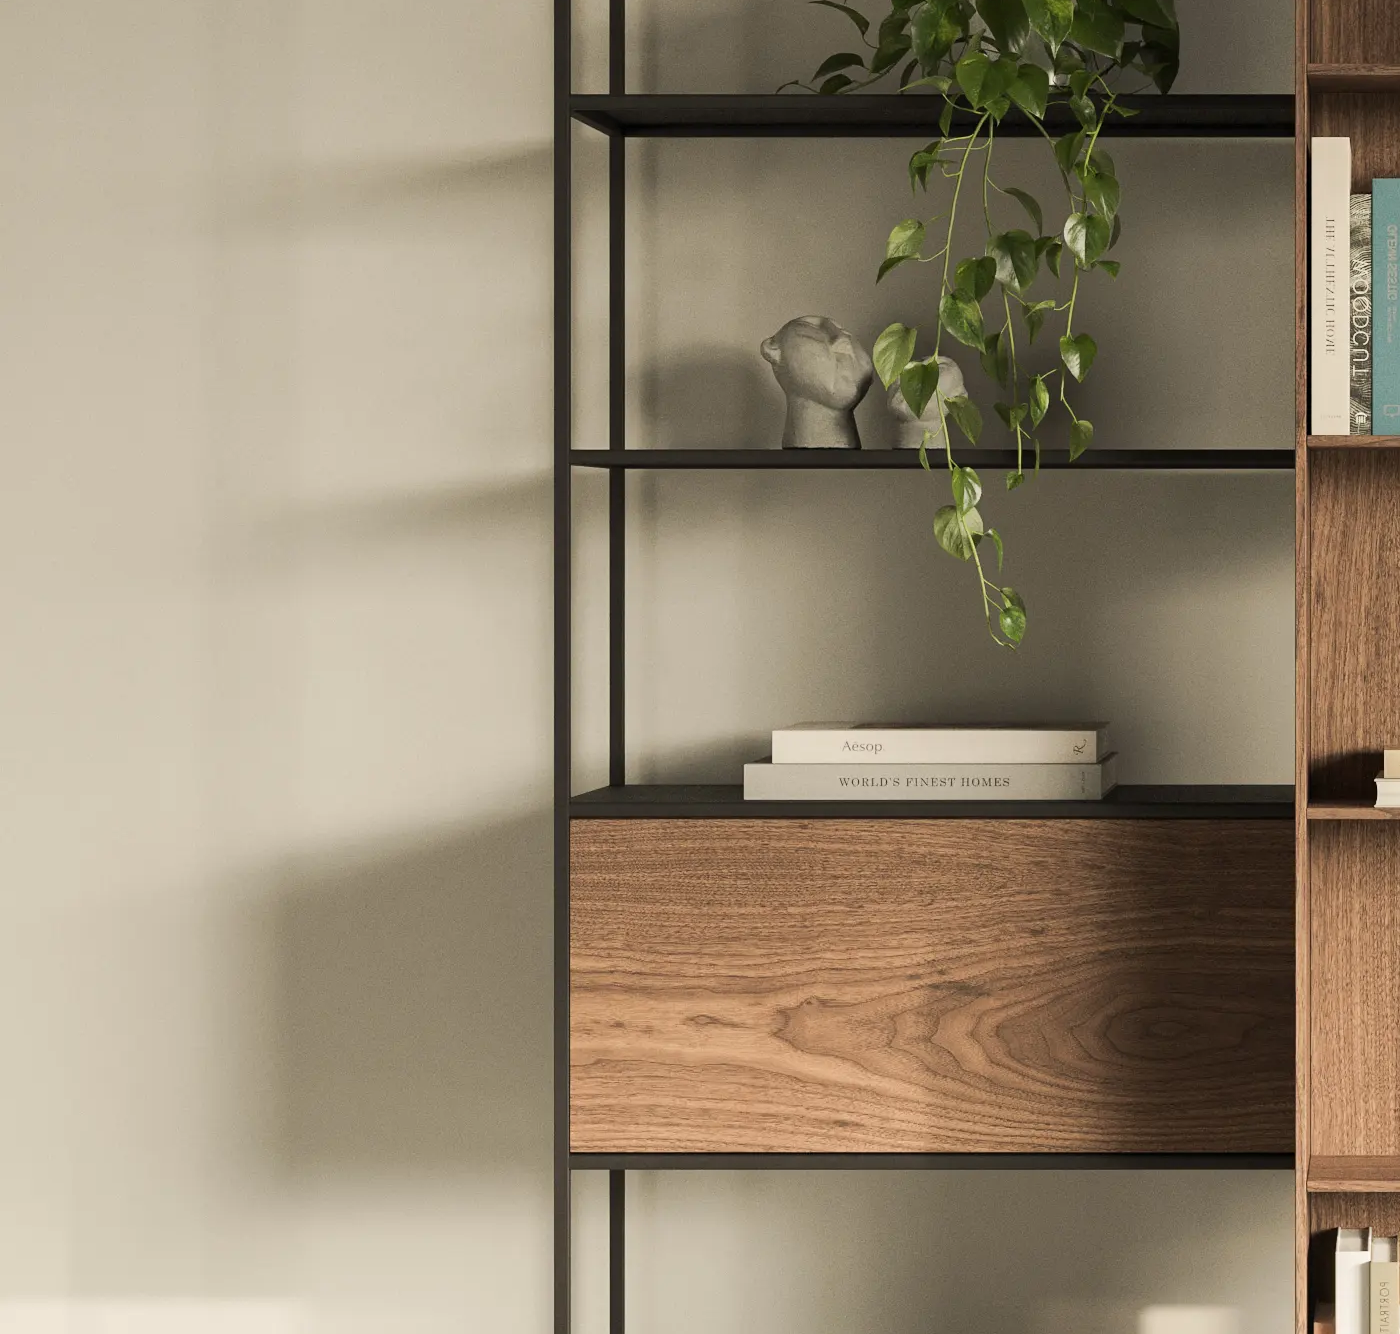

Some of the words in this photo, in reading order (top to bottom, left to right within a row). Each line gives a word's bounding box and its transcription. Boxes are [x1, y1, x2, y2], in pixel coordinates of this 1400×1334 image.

[839, 777, 900, 787] WORLD'S
[906, 777, 956, 787] FINEST
[961, 777, 1010, 787] HOMES
